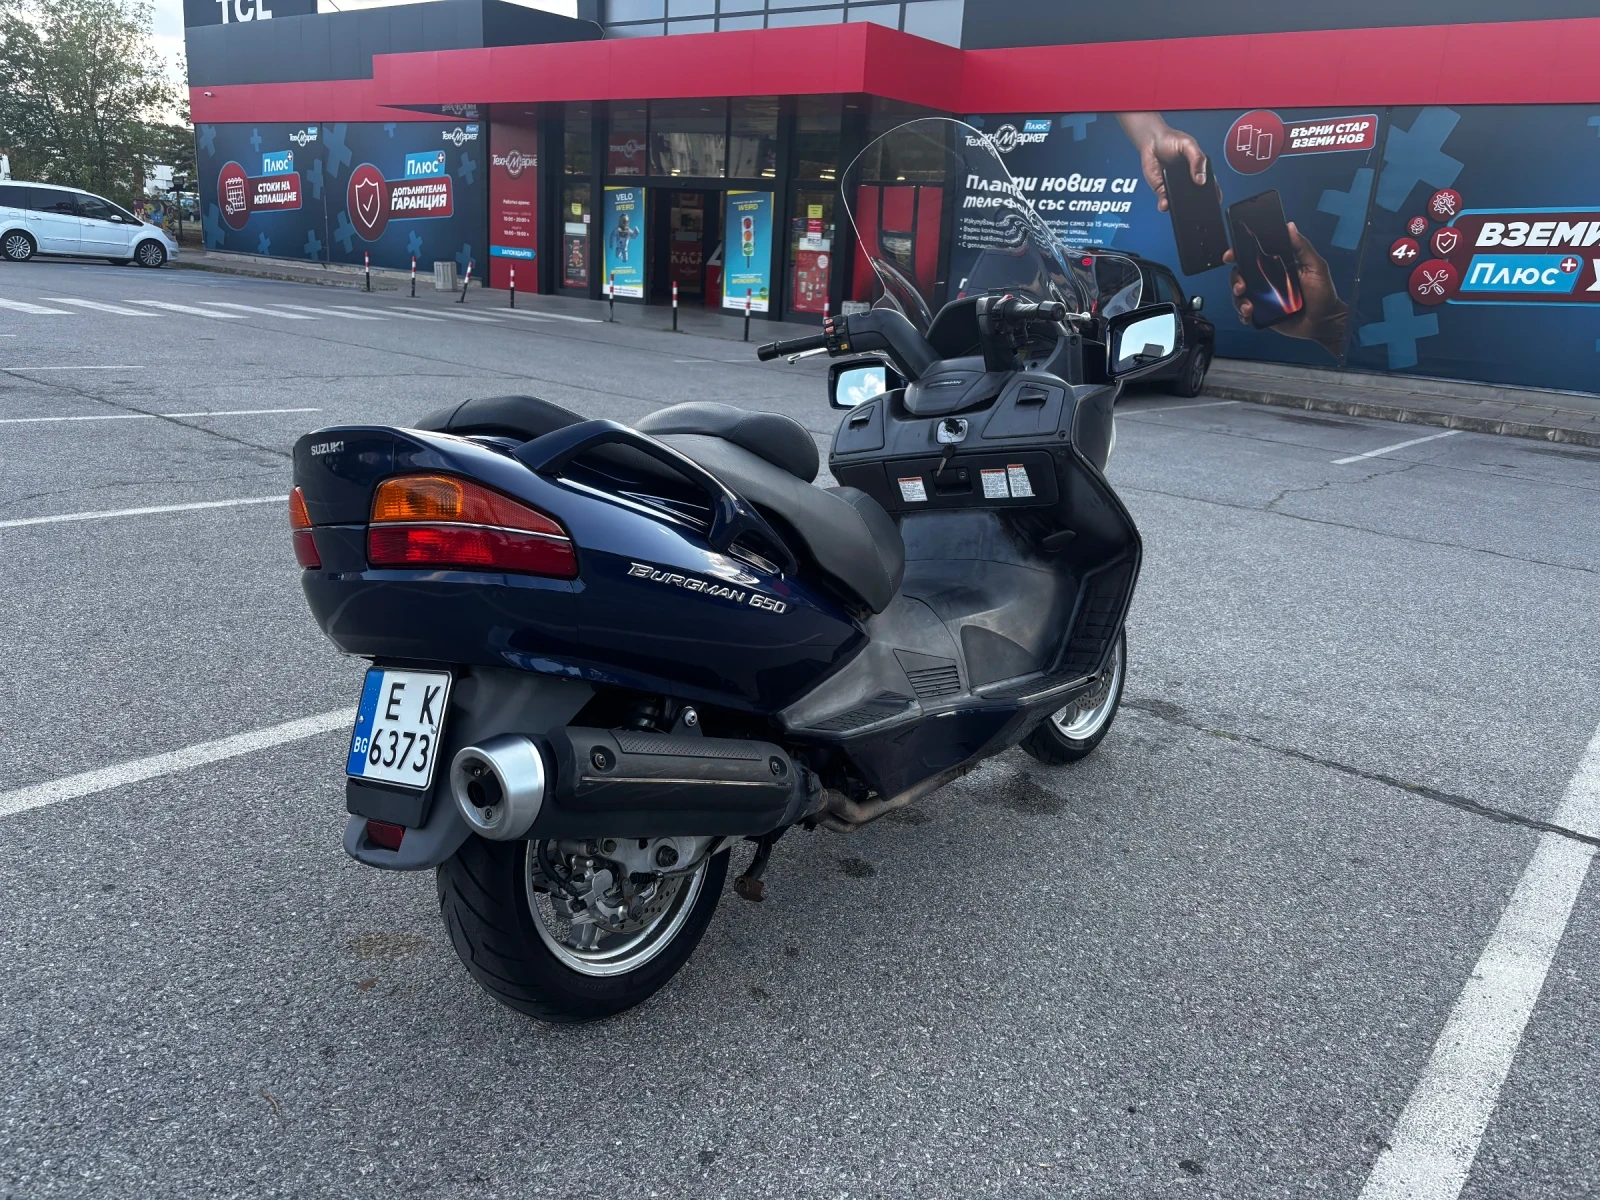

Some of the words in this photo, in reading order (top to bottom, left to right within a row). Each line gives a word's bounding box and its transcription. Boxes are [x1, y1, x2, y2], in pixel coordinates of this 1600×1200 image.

[216, 0, 273, 24] TCL
[1290, 124, 1334, 138] ВЪРНИ
[1335, 121, 1369, 134] СТАР
[1291, 135, 1336, 148] ВЗЕМИ
[1336, 133, 1365, 145] НОВ
[264, 158, 289, 173] Плюс
[407, 159, 439, 175] Плюс
[257, 182, 281, 193] СТОКИ
[281, 180, 291, 191] НА
[392, 183, 447, 198] ДОПЪЛНИТЕЛНА
[1040, 173, 1107, 193] новия
[1111, 178, 1138, 194] си
[253, 191, 297, 205] ИЗПЛАЩАНЕ
[391, 194, 447, 210] ГАРАНЦИЯ
[616, 193, 633, 201] VELO
[1038, 198, 1065, 211] със
[1068, 201, 1132, 215] стария
[1392, 244, 1416, 259] 4+
[1469, 262, 1560, 285] Плюс
[311, 440, 345, 456] SUZUKI
[748, 594, 787, 614] 650
[385, 682, 406, 720] E
[419, 685, 442, 725] K
[353, 736, 368, 754] BG
[369, 728, 430, 773] 6373
